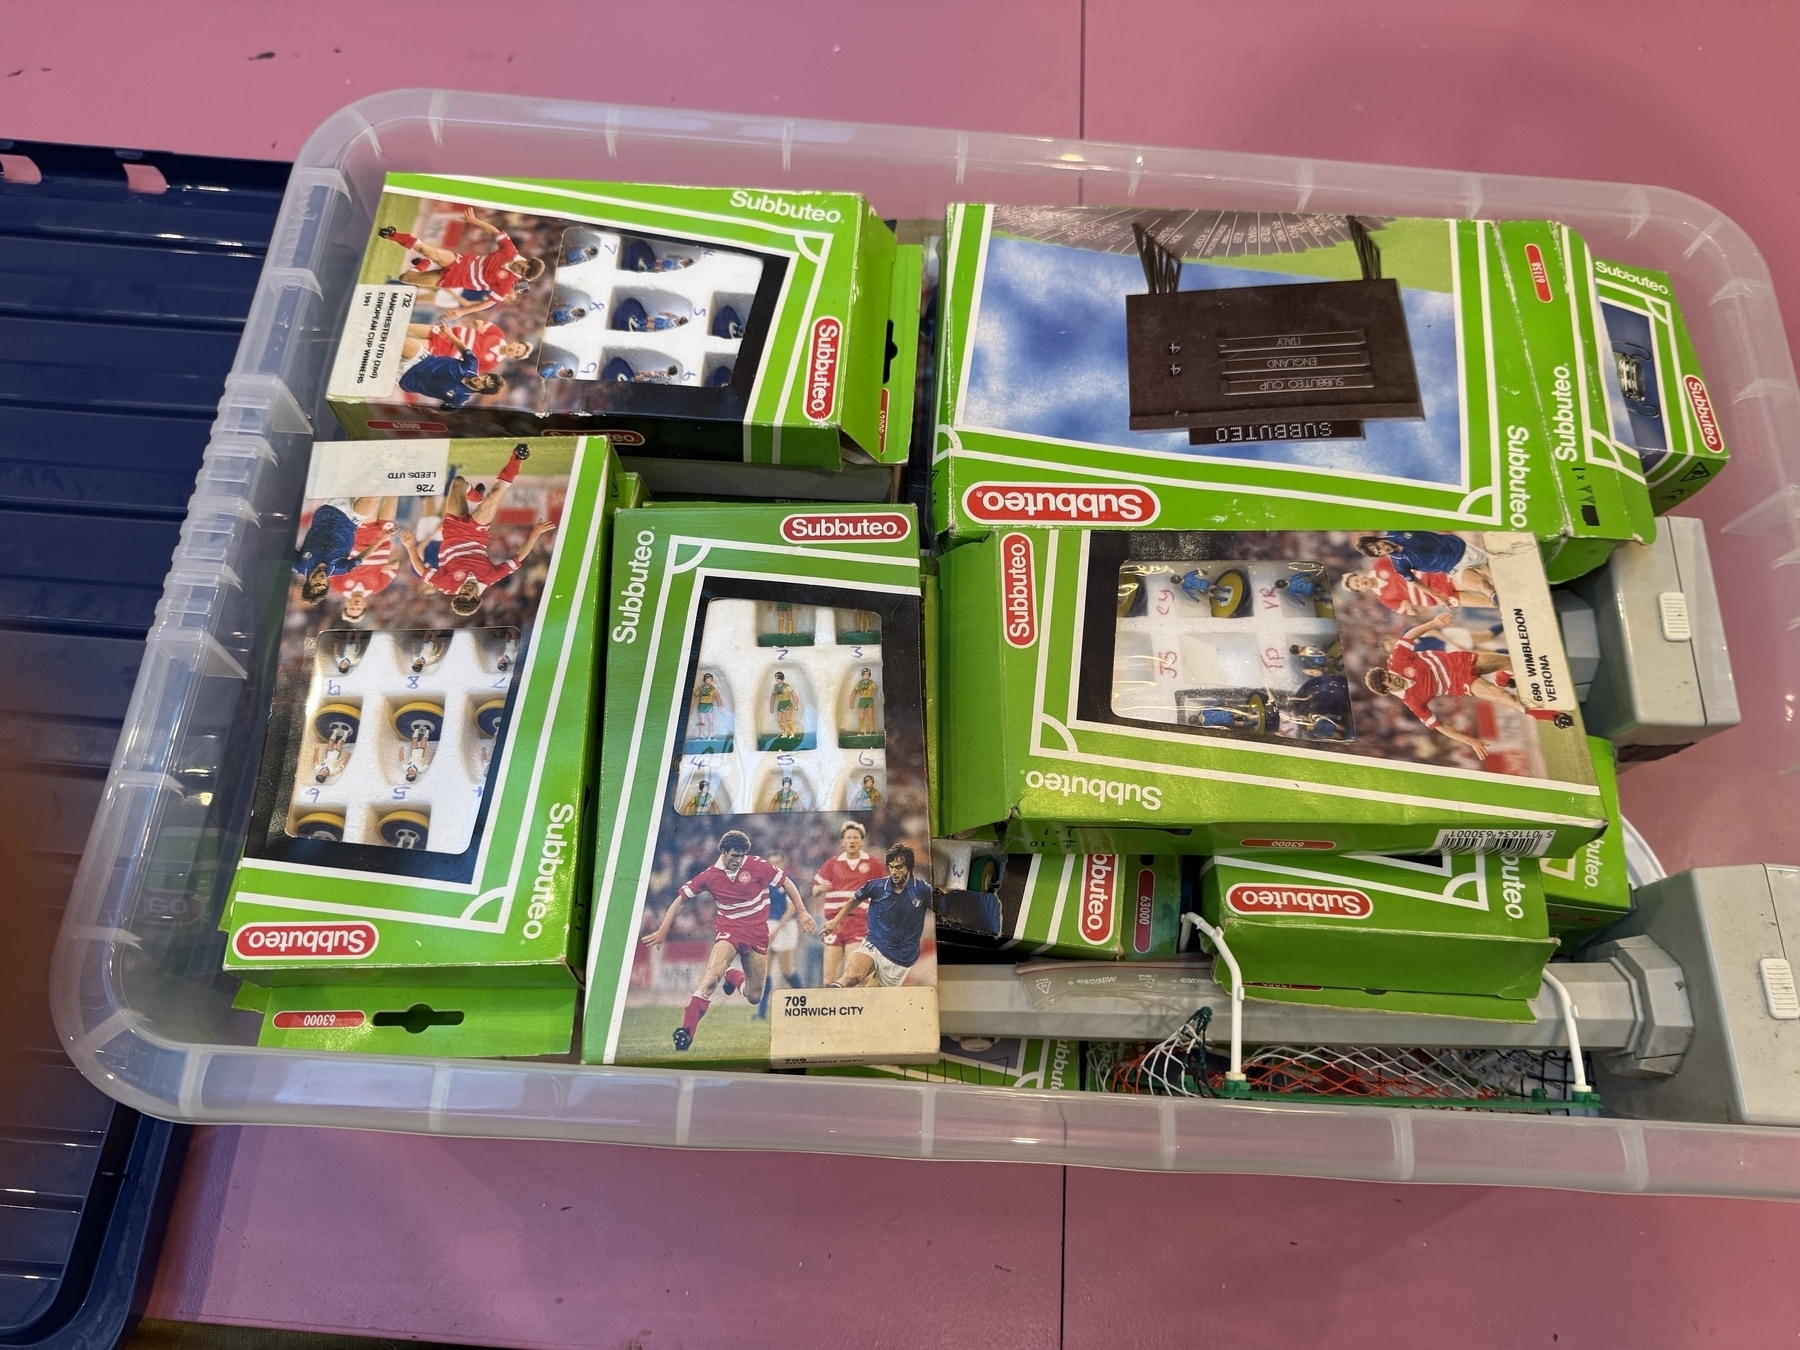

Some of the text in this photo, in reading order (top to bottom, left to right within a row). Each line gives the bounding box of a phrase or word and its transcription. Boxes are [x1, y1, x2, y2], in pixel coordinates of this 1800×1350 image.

[730, 190, 842, 225] Subbuteo
[1595, 261, 1669, 295] Subbuteo
[362, 292, 372, 307] 1991
[402, 292, 412, 308] 732
[380, 292, 398, 342] MANCHESTER
[356, 292, 386, 384] EUROPEAN CUP WINNERS
[376, 343, 386, 359] UTD
[1276, 337, 1301, 347] ITALY
[809, 318, 840, 414] Subbuteo
[1267, 357, 1317, 368] ENGLAND
[1259, 377, 1344, 390] SUBBUTEO CUP
[393, 422, 421, 430] 63000
[1551, 366, 1577, 462] Subbuteo
[1688, 381, 1717, 446] Subbuteo
[1215, 422, 1332, 442] SUBBUTEO
[387, 471, 437, 480] LEEDS UTD
[416, 484, 435, 493] 726
[1507, 425, 1531, 528] Subbuteo
[983, 490, 1143, 520] Subbuteo
[791, 518, 898, 537] Subbuteo
[613, 530, 654, 644] Subbuteo
[1008, 540, 1035, 642] Subbuteo
[1513, 608, 1543, 702] 690 WIMBLEDON
[1538, 655, 1557, 702] VERONA
[1026, 770, 1163, 812] Subbuteo
[1271, 840, 1305, 848] 63000
[524, 802, 574, 940] Subbuteo
[1584, 839, 1605, 887] buteo
[1087, 854, 1112, 930] bbuteo
[1237, 887, 1363, 917] Subbuteo
[1139, 895, 1151, 925] 63000
[248, 929, 368, 953] Subbuteo
[1076, 976, 1118, 985] MINIGRIP
[784, 996, 807, 1007] 709
[784, 1006, 864, 1017] NORWICH CITY
[304, 1014, 336, 1025] 63000
